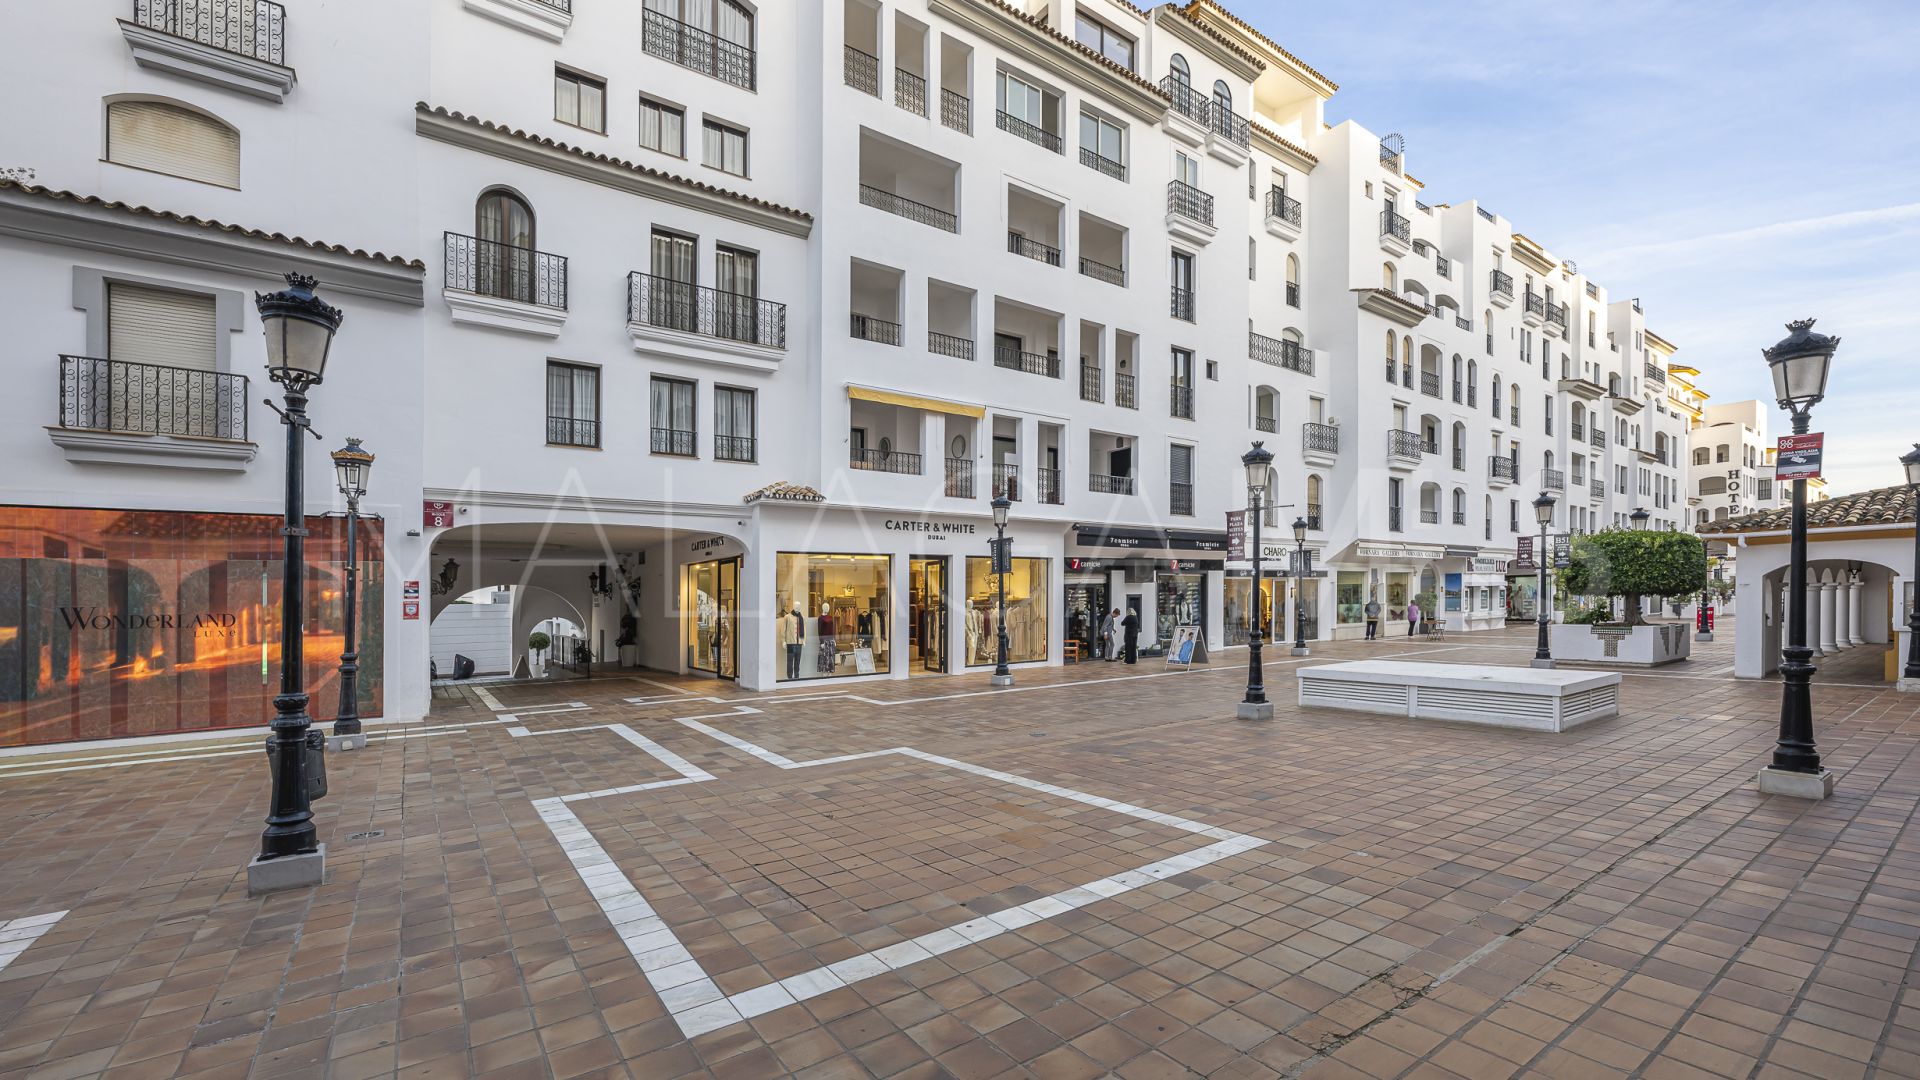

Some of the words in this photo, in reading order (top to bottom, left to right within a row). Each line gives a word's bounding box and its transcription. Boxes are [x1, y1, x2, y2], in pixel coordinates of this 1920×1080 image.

[434, 516, 443, 527] 8
[885, 519, 930, 532] CARTER
[933, 523, 940, 532] &
[942, 523, 975, 534] WHITE
[1263, 546, 1287, 557] CHARO
[1073, 558, 1080, 569] 7
[1172, 559, 1178, 569] 7
[1495, 560, 1506, 572] LUZ
